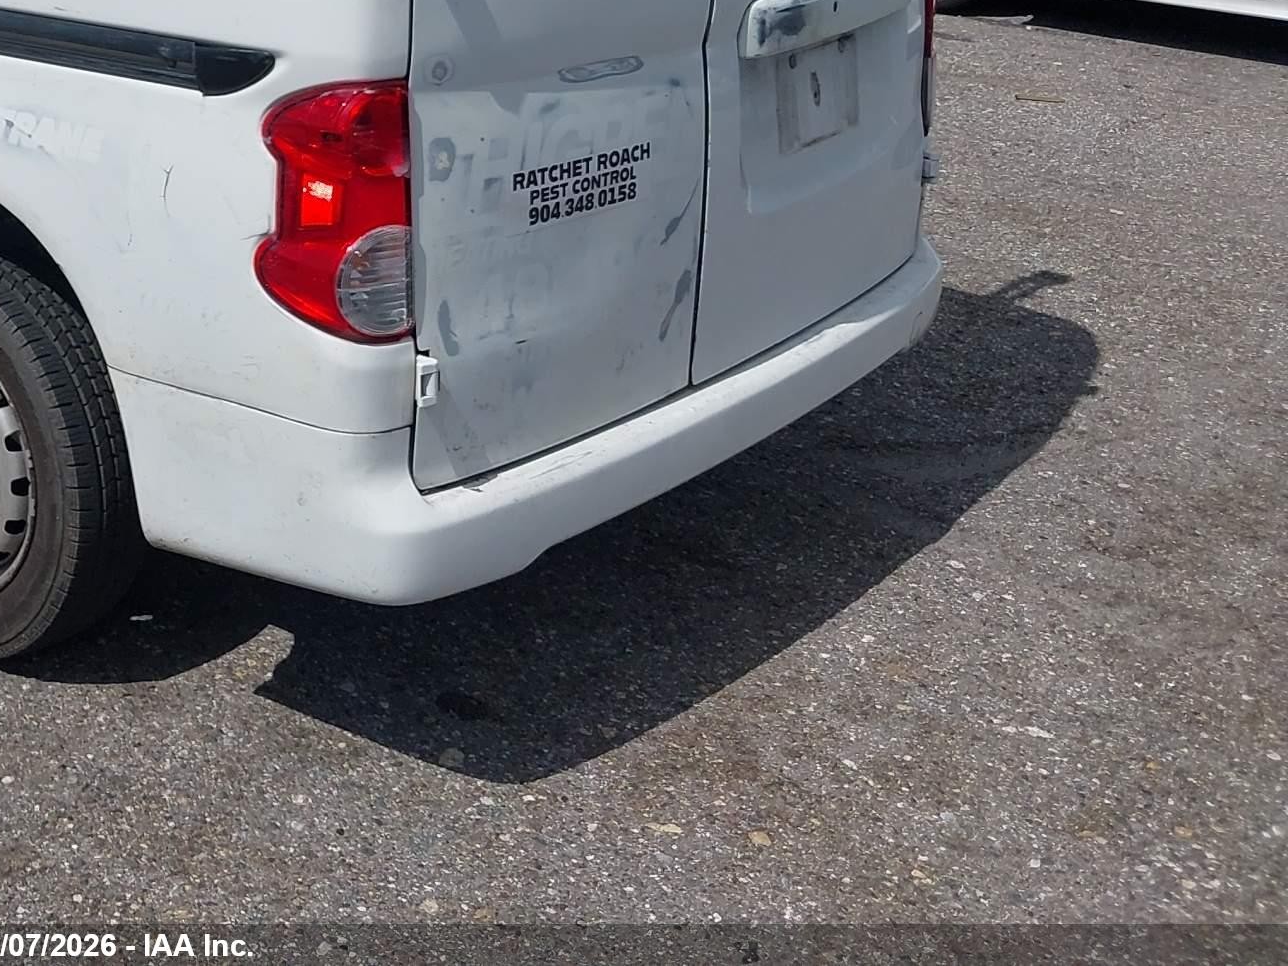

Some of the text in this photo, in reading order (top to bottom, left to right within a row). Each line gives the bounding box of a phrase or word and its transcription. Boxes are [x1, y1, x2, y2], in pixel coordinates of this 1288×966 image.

[512, 141, 651, 191] RATCHET ROACH
[529, 165, 637, 205] PEST CONTROL
[528, 181, 637, 227] 904.348.0158
